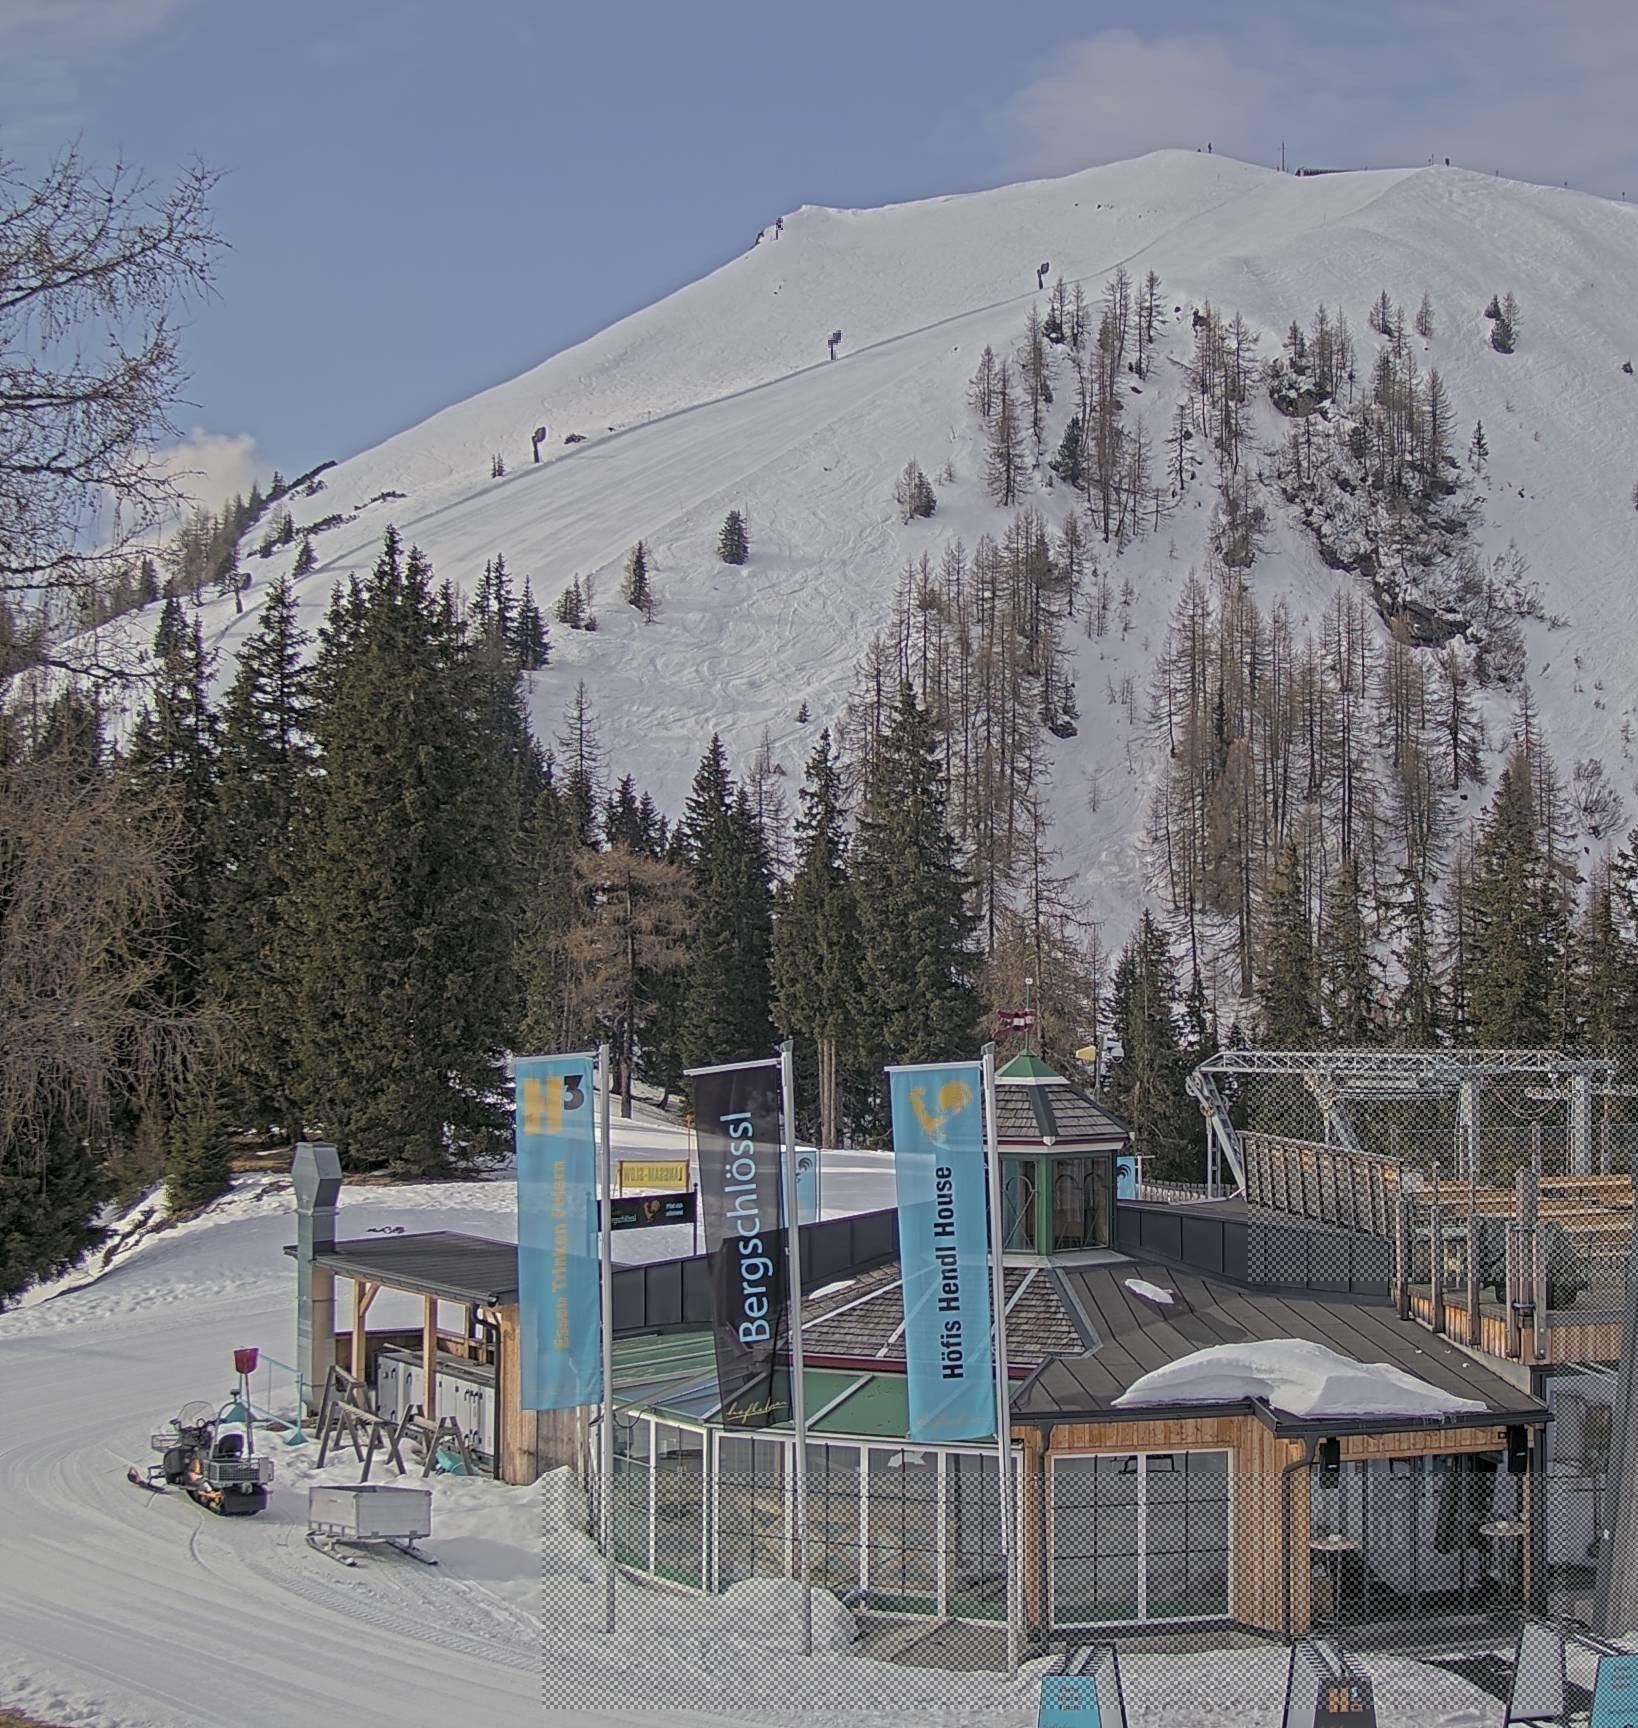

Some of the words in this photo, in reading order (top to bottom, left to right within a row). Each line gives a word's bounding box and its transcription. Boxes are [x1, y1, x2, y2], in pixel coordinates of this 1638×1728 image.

[720, 1110, 773, 1343] Bergschlössl
[933, 1165, 956, 1238] House
[937, 1245, 961, 1313] Hendl
[941, 1321, 965, 1380] Höfis
